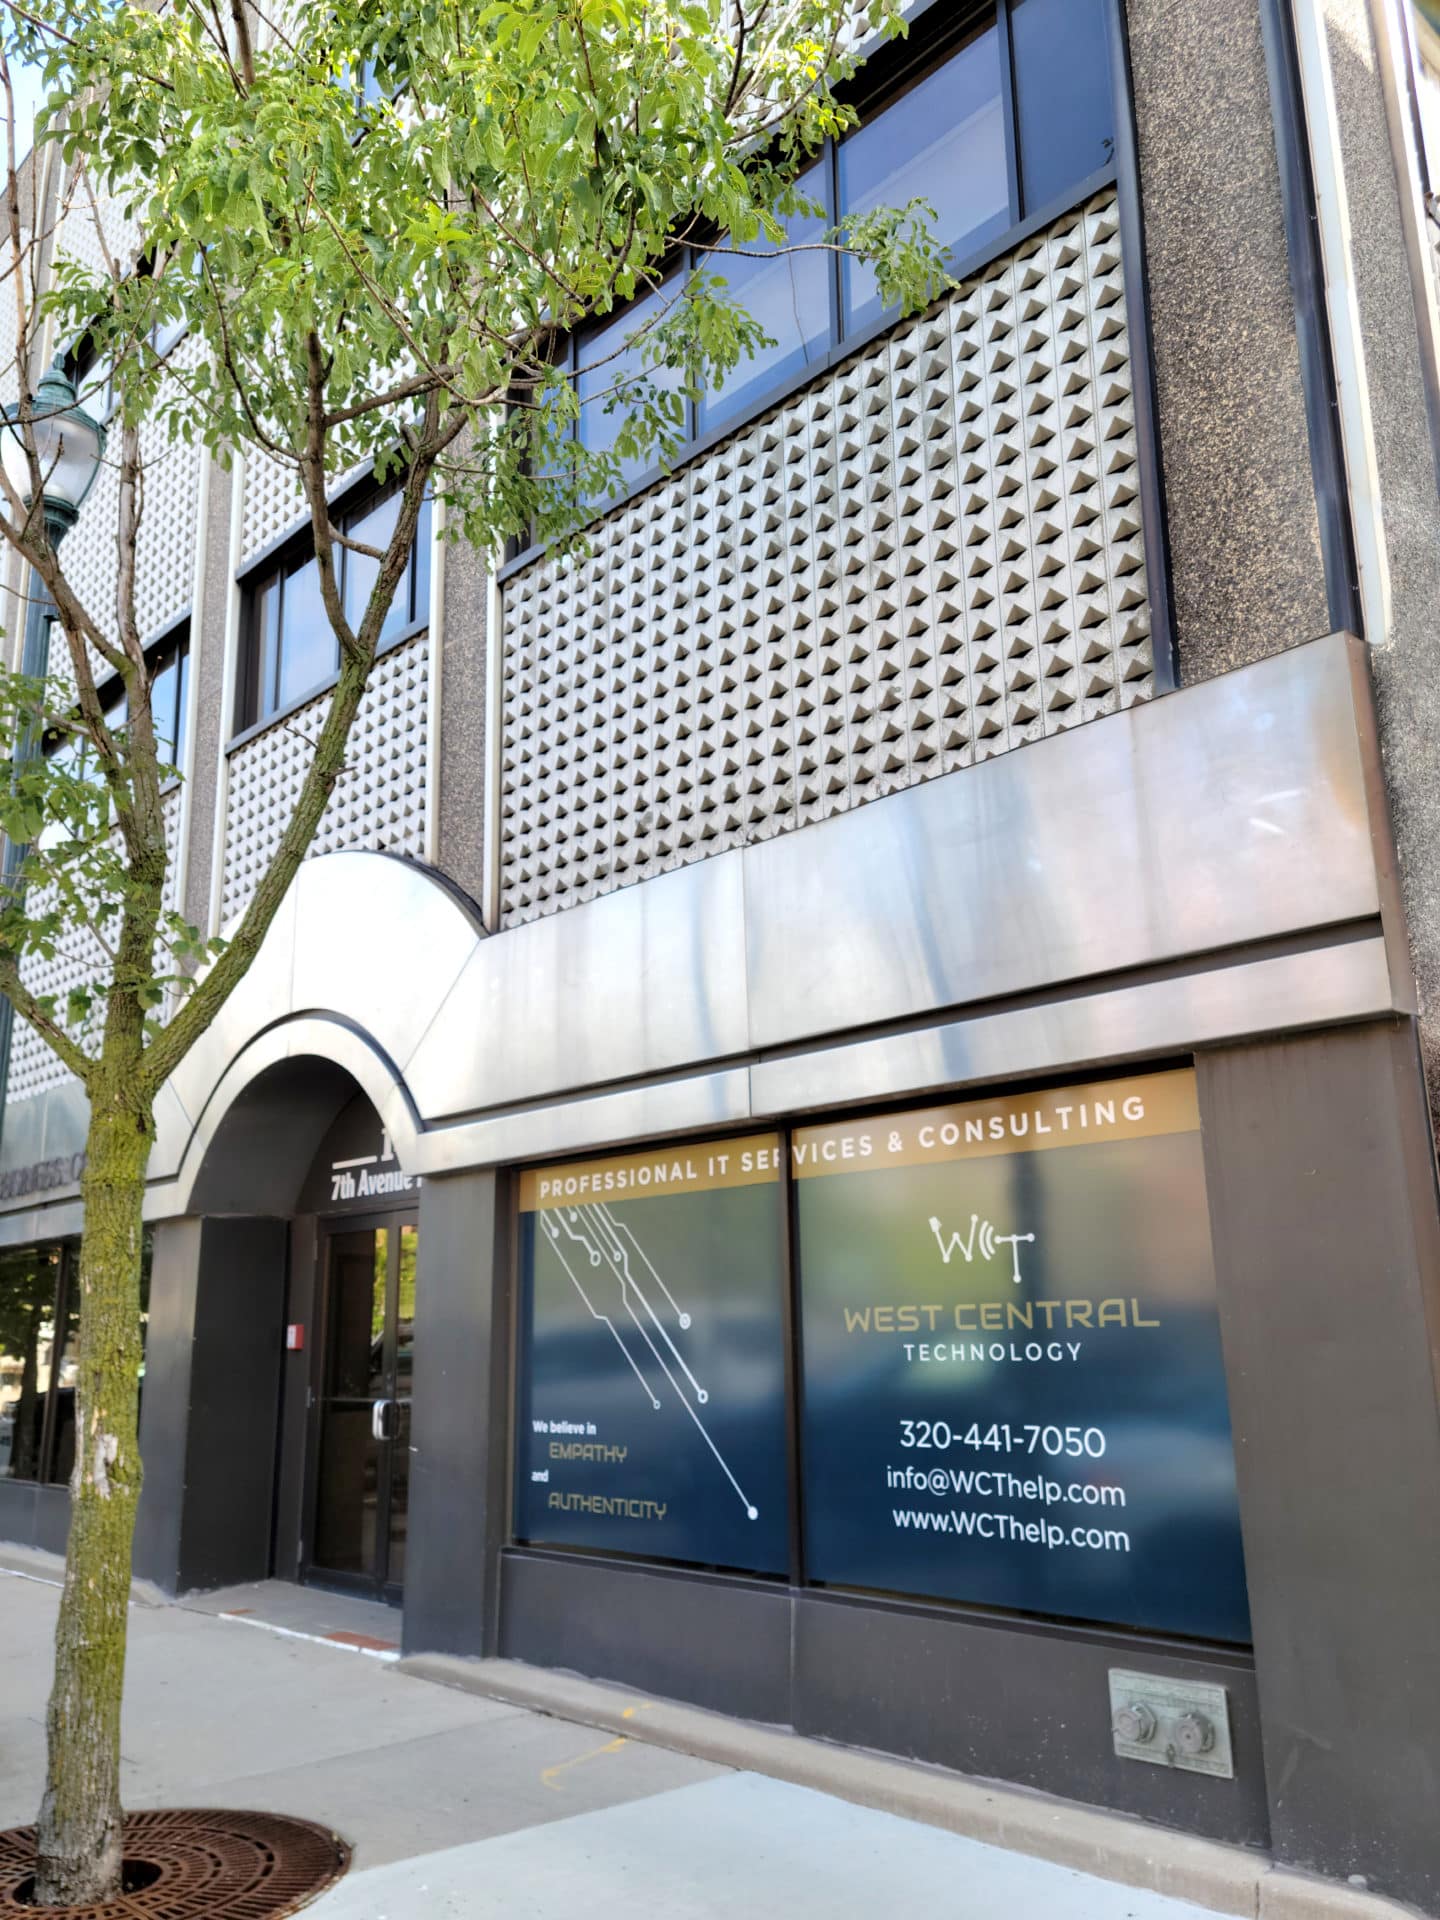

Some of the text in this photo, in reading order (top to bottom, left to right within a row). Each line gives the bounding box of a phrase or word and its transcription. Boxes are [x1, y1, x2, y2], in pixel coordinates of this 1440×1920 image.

[540, 1161, 697, 1199] PROFESSIONAL
[707, 1154, 729, 1177] IT
[887, 1132, 904, 1153] &
[918, 1096, 1146, 1148] CONSULTING
[331, 1171, 356, 1201] 7th
[357, 1169, 414, 1197] Avenue
[844, 1297, 1161, 1333] WEST CENTRAL
[903, 1342, 1082, 1362] TECHNOLOGY
[532, 1420, 597, 1435] We believe in
[900, 1420, 1106, 1458] 320-441-7050
[550, 1442, 628, 1463] EMPATHY
[531, 1469, 549, 1483] and
[887, 1465, 1126, 1507] info@WCThelp.com
[548, 1492, 668, 1521] AUTHENTICITY
[892, 1509, 1131, 1552] www.WCThelp.com
